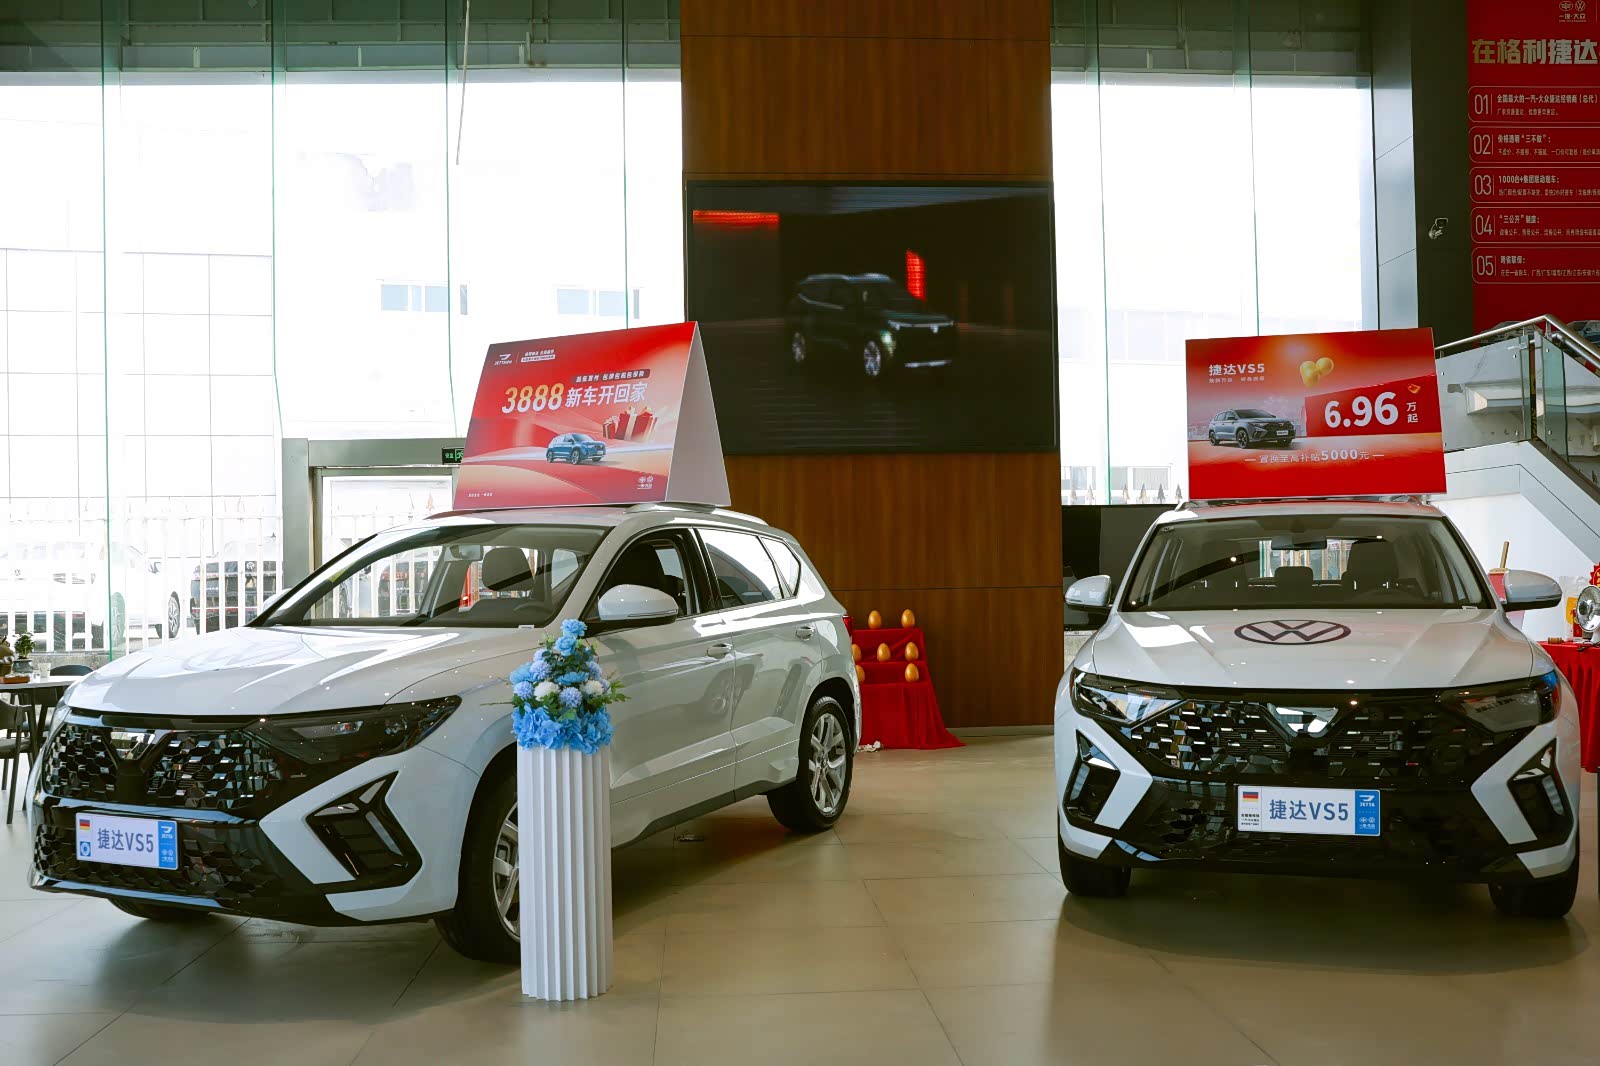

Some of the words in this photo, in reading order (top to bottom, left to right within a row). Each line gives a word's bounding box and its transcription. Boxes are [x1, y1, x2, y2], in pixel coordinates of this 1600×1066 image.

[1471, 39, 1598, 64] 在格利捷达
[1474, 94, 1489, 115] 01
[1473, 134, 1491, 155] 02
[1474, 175, 1492, 195] 03
[1475, 215, 1493, 236] 04
[1476, 255, 1494, 276] 05
[1208, 363, 1265, 377] 捷达VS5
[501, 382, 564, 414] 3888
[564, 381, 648, 408] 新车开回家
[1324, 391, 1399, 428] 6.96
[1269, 799, 1349, 821] 捷达VS5
[97, 827, 154, 853] 捷达VS5
